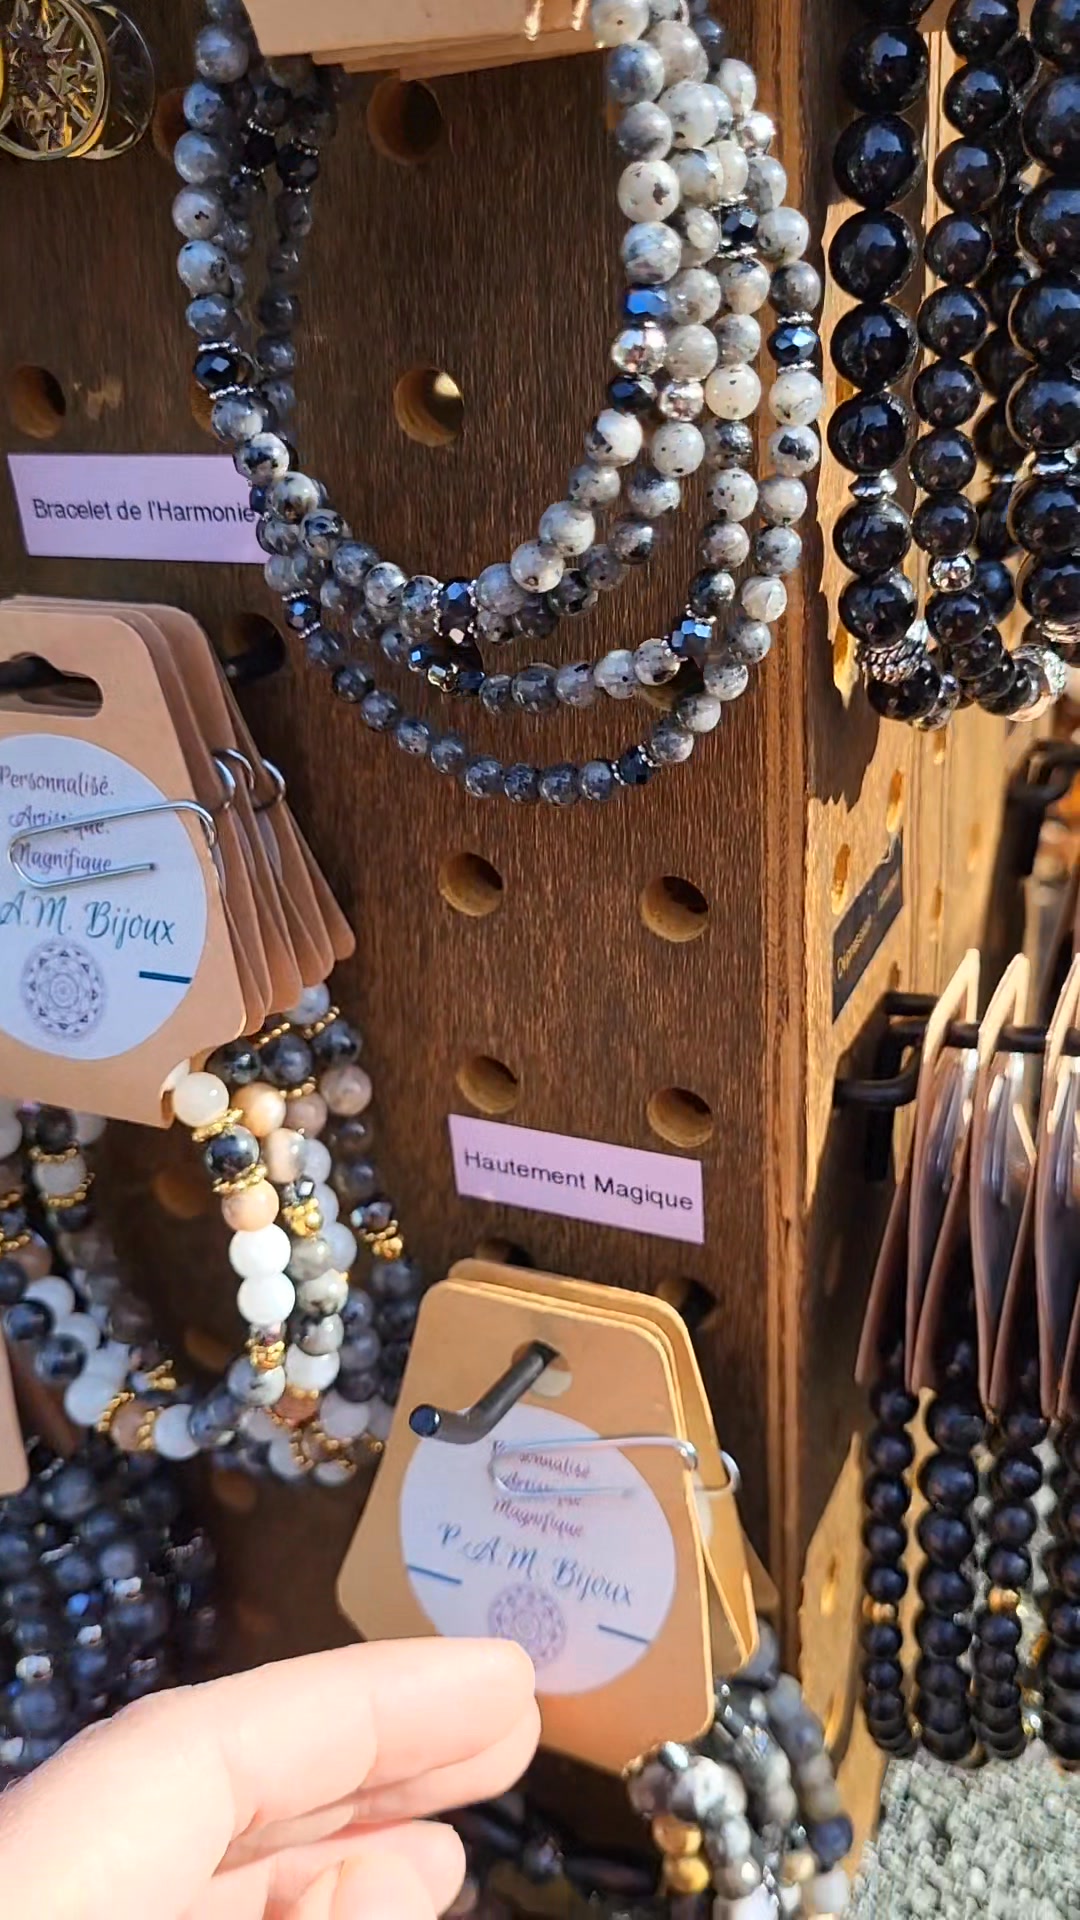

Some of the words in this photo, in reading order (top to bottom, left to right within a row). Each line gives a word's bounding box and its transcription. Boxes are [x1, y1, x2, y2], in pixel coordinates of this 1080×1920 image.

[32, 498, 112, 520] Bracelet
[116, 501, 142, 521] de
[148, 501, 256, 524] l'Harmonie
[85, 901, 176, 949] Bijoux
[464, 1148, 586, 1190] Hautement
[594, 1173, 694, 1211] Magique
[553, 1557, 632, 1606] Bijoux
